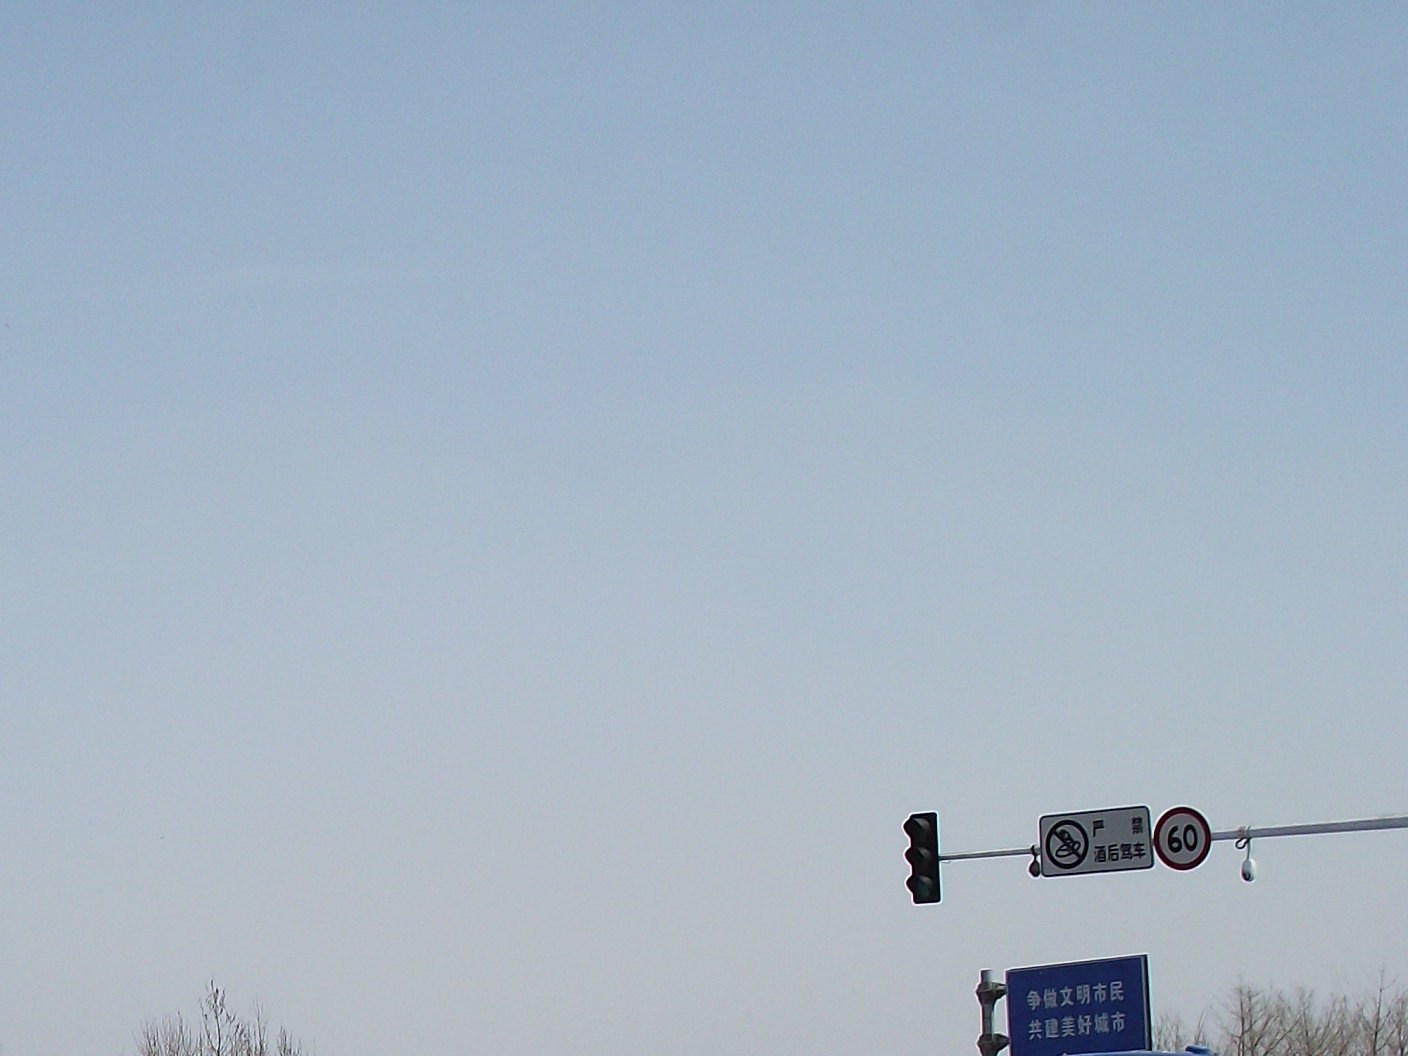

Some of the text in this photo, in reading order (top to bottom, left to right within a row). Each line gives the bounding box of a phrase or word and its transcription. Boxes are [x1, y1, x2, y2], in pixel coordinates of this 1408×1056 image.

[1094, 842, 1146, 863] 酒后驾车
[1167, 824, 1198, 853] 60
[1027, 981, 1124, 1010] 争做文明市民
[1028, 1012, 1125, 1040] 共建美好城市
